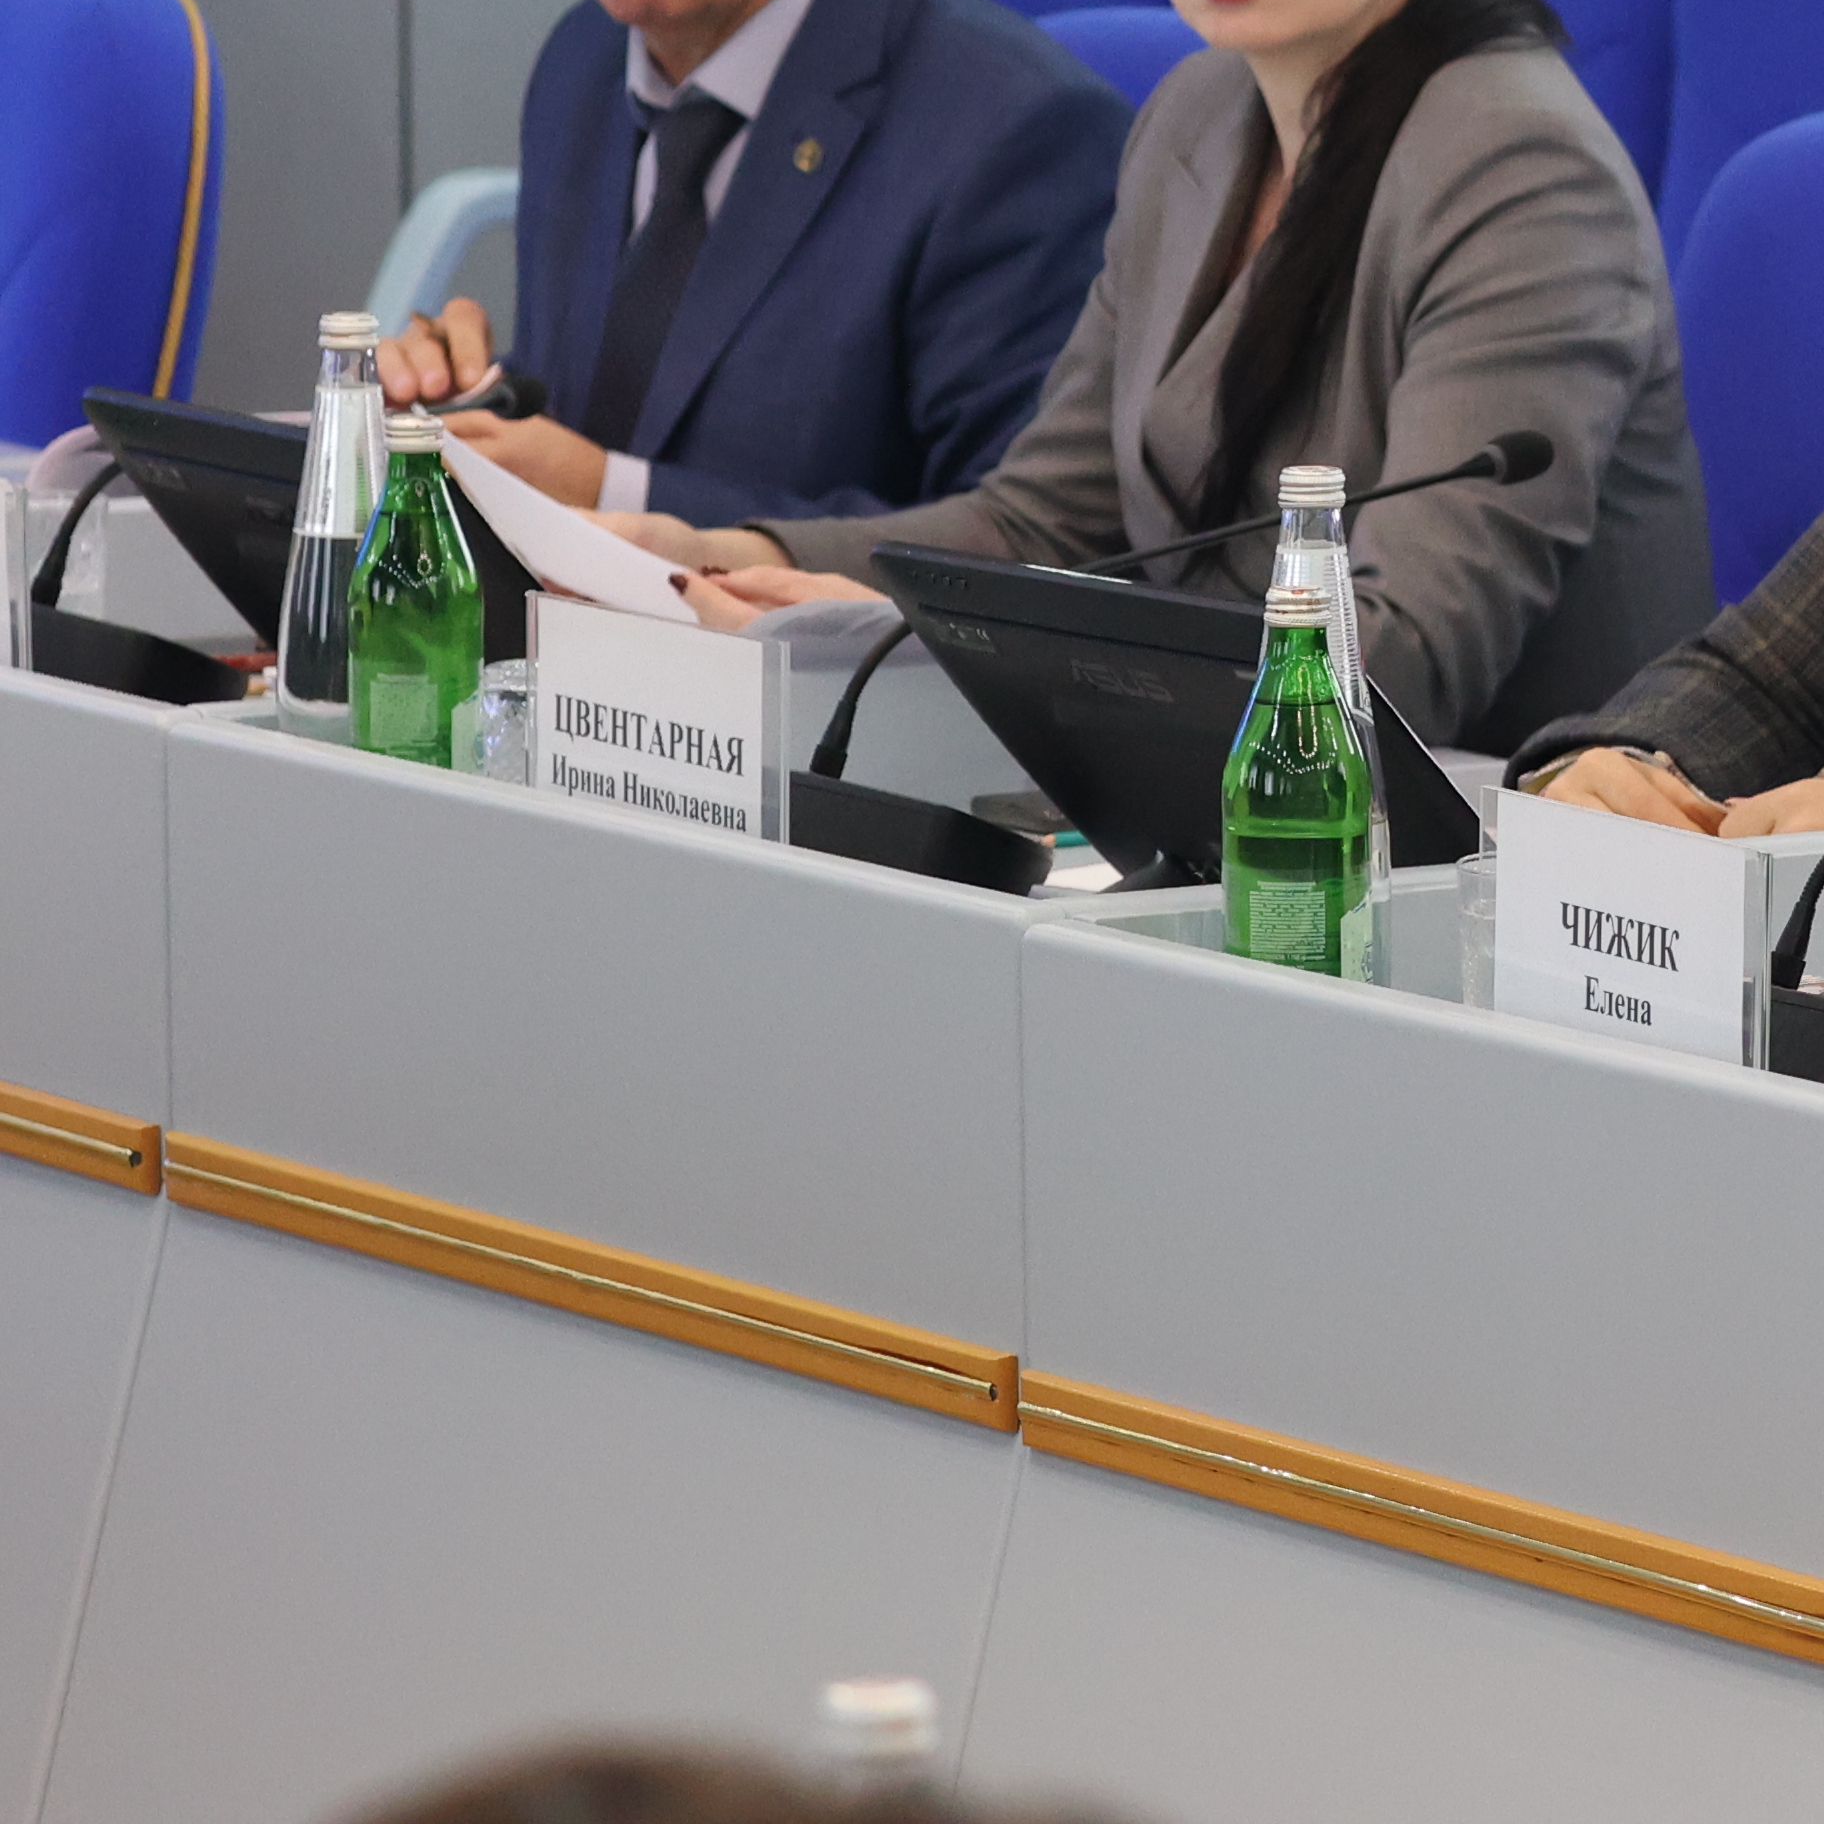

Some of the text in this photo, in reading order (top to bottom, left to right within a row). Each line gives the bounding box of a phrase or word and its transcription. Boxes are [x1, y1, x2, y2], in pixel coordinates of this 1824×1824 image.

[554, 693, 744, 777] ЦВЕНТАРНАЯ
[551, 753, 748, 834] Ирина Николаевна
[1560, 901, 1681, 973] ЧИЖИК
[1584, 975, 1653, 1027] Елена
